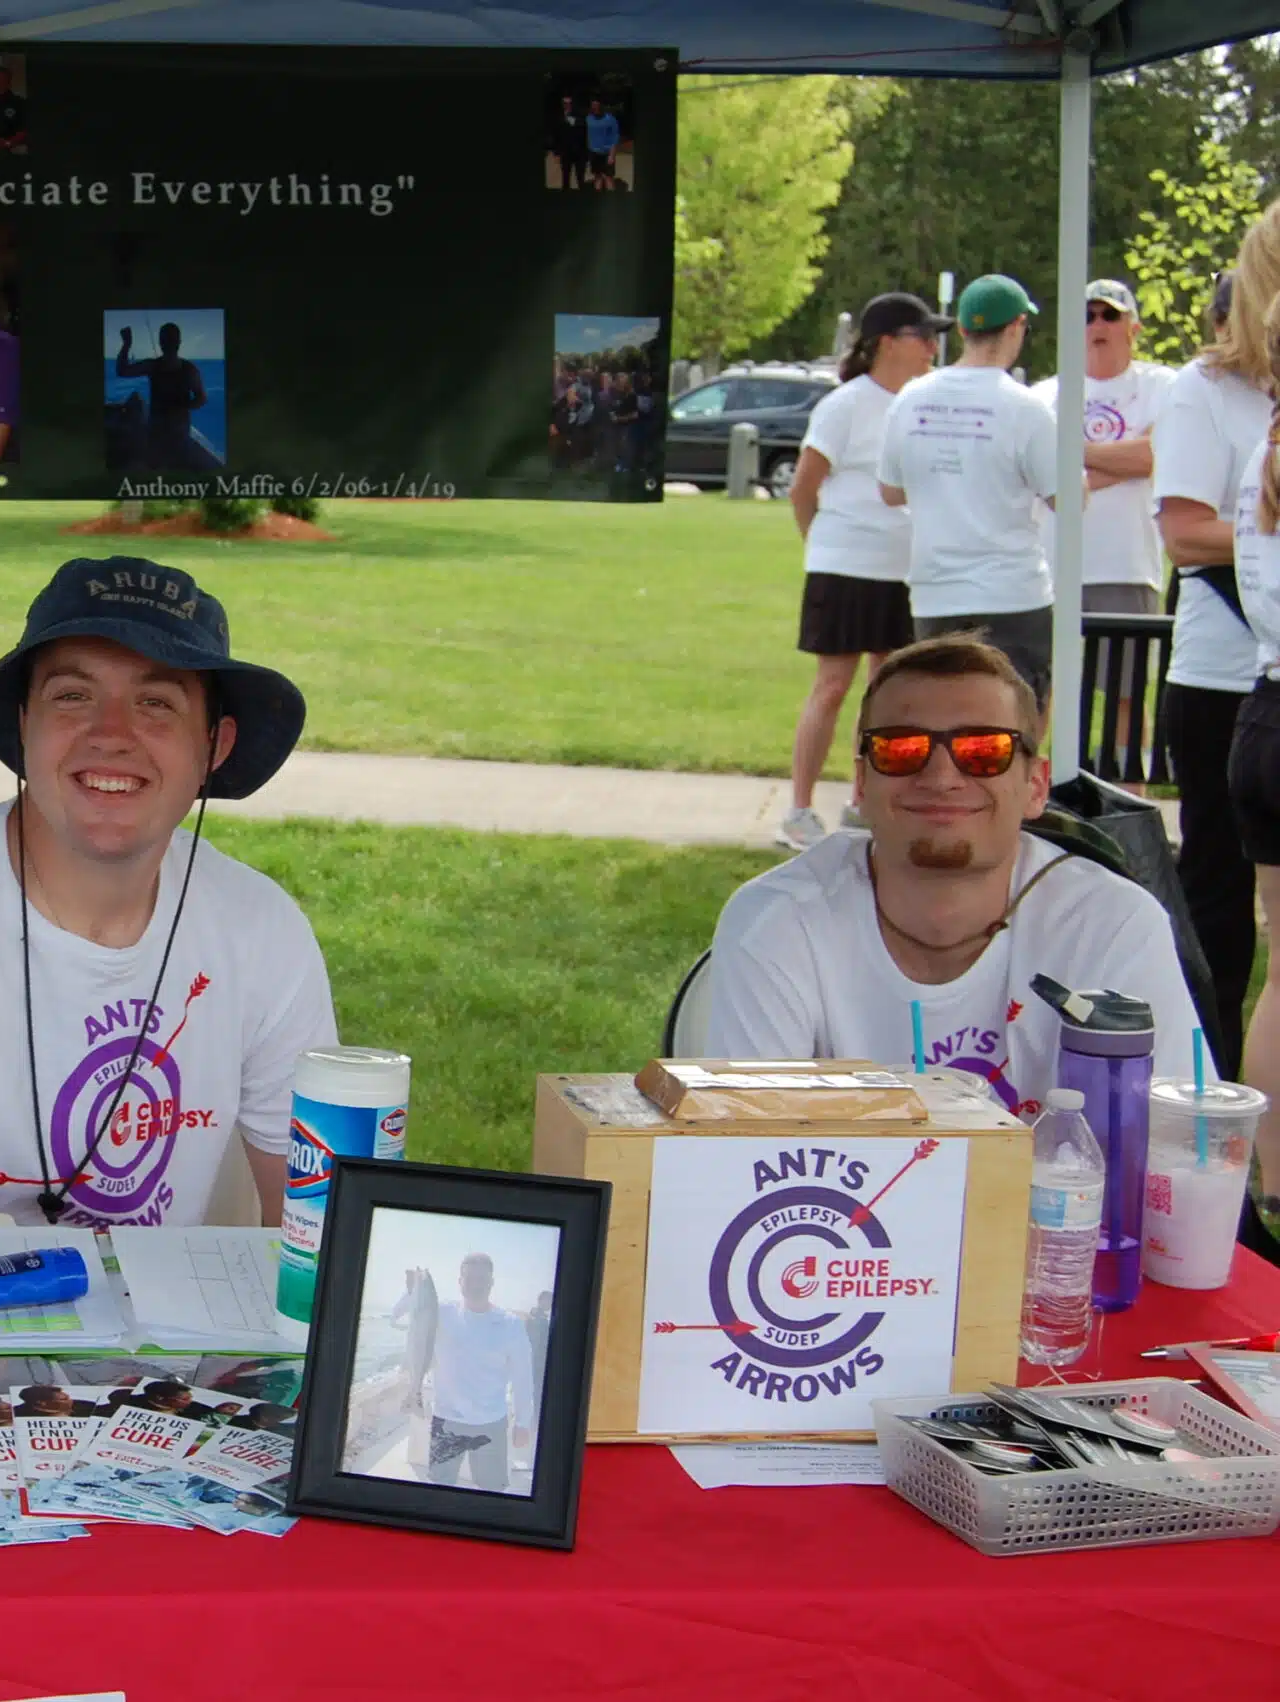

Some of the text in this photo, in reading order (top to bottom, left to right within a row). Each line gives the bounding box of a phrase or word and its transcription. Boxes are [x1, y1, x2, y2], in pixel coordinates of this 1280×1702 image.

[117, 475, 210, 499] Anthony
[216, 474, 286, 497] Maffie
[86, 571, 198, 620] ARUBA
[84, 999, 165, 1046] ANTS
[287, 1139, 326, 1177] ROX
[752, 1148, 870, 1192] ANT'S
[96, 1176, 137, 1194] SUDEP
[760, 1207, 842, 1233] EPILEPSY
[827, 1260, 890, 1277] CURE
[826, 1278, 934, 1298] EPILEPSY
[764, 1326, 821, 1346] SUDEP
[710, 1346, 885, 1402] ARROWS
[27, 1421, 67, 1429] HELP
[120, 1418, 184, 1439] FIND A
[125, 1410, 191, 1431] HELP US
[28, 1429, 74, 1438] FIND
[110, 1427, 181, 1451] CURE
